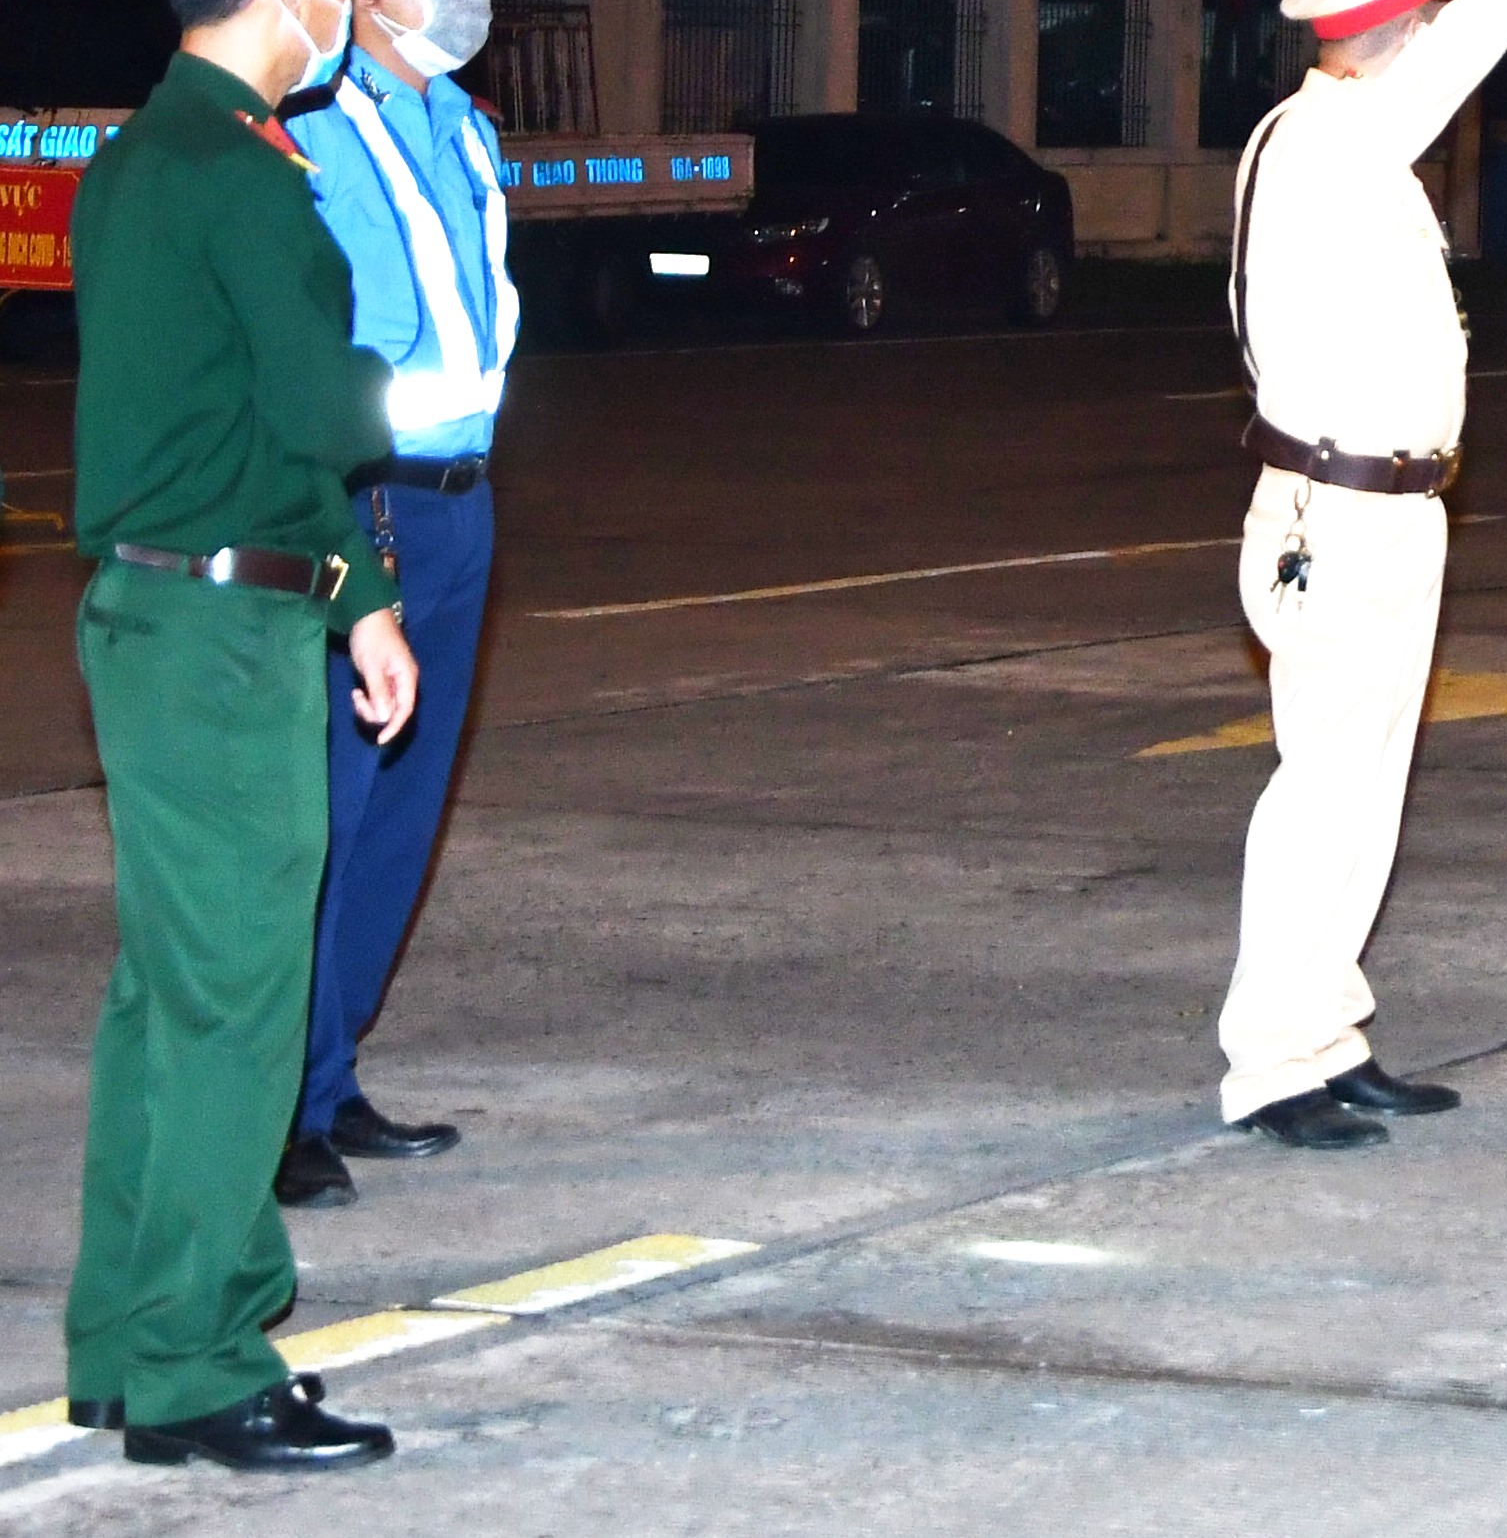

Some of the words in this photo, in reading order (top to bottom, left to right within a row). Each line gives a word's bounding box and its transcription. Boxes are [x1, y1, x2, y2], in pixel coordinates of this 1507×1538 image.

[0, 119, 39, 157] SÁT
[40, 124, 98, 158] GIAO
[499, 158, 522, 187] ÁT
[532, 159, 576, 187] GIAO
[585, 155, 644, 184] THÔNG
